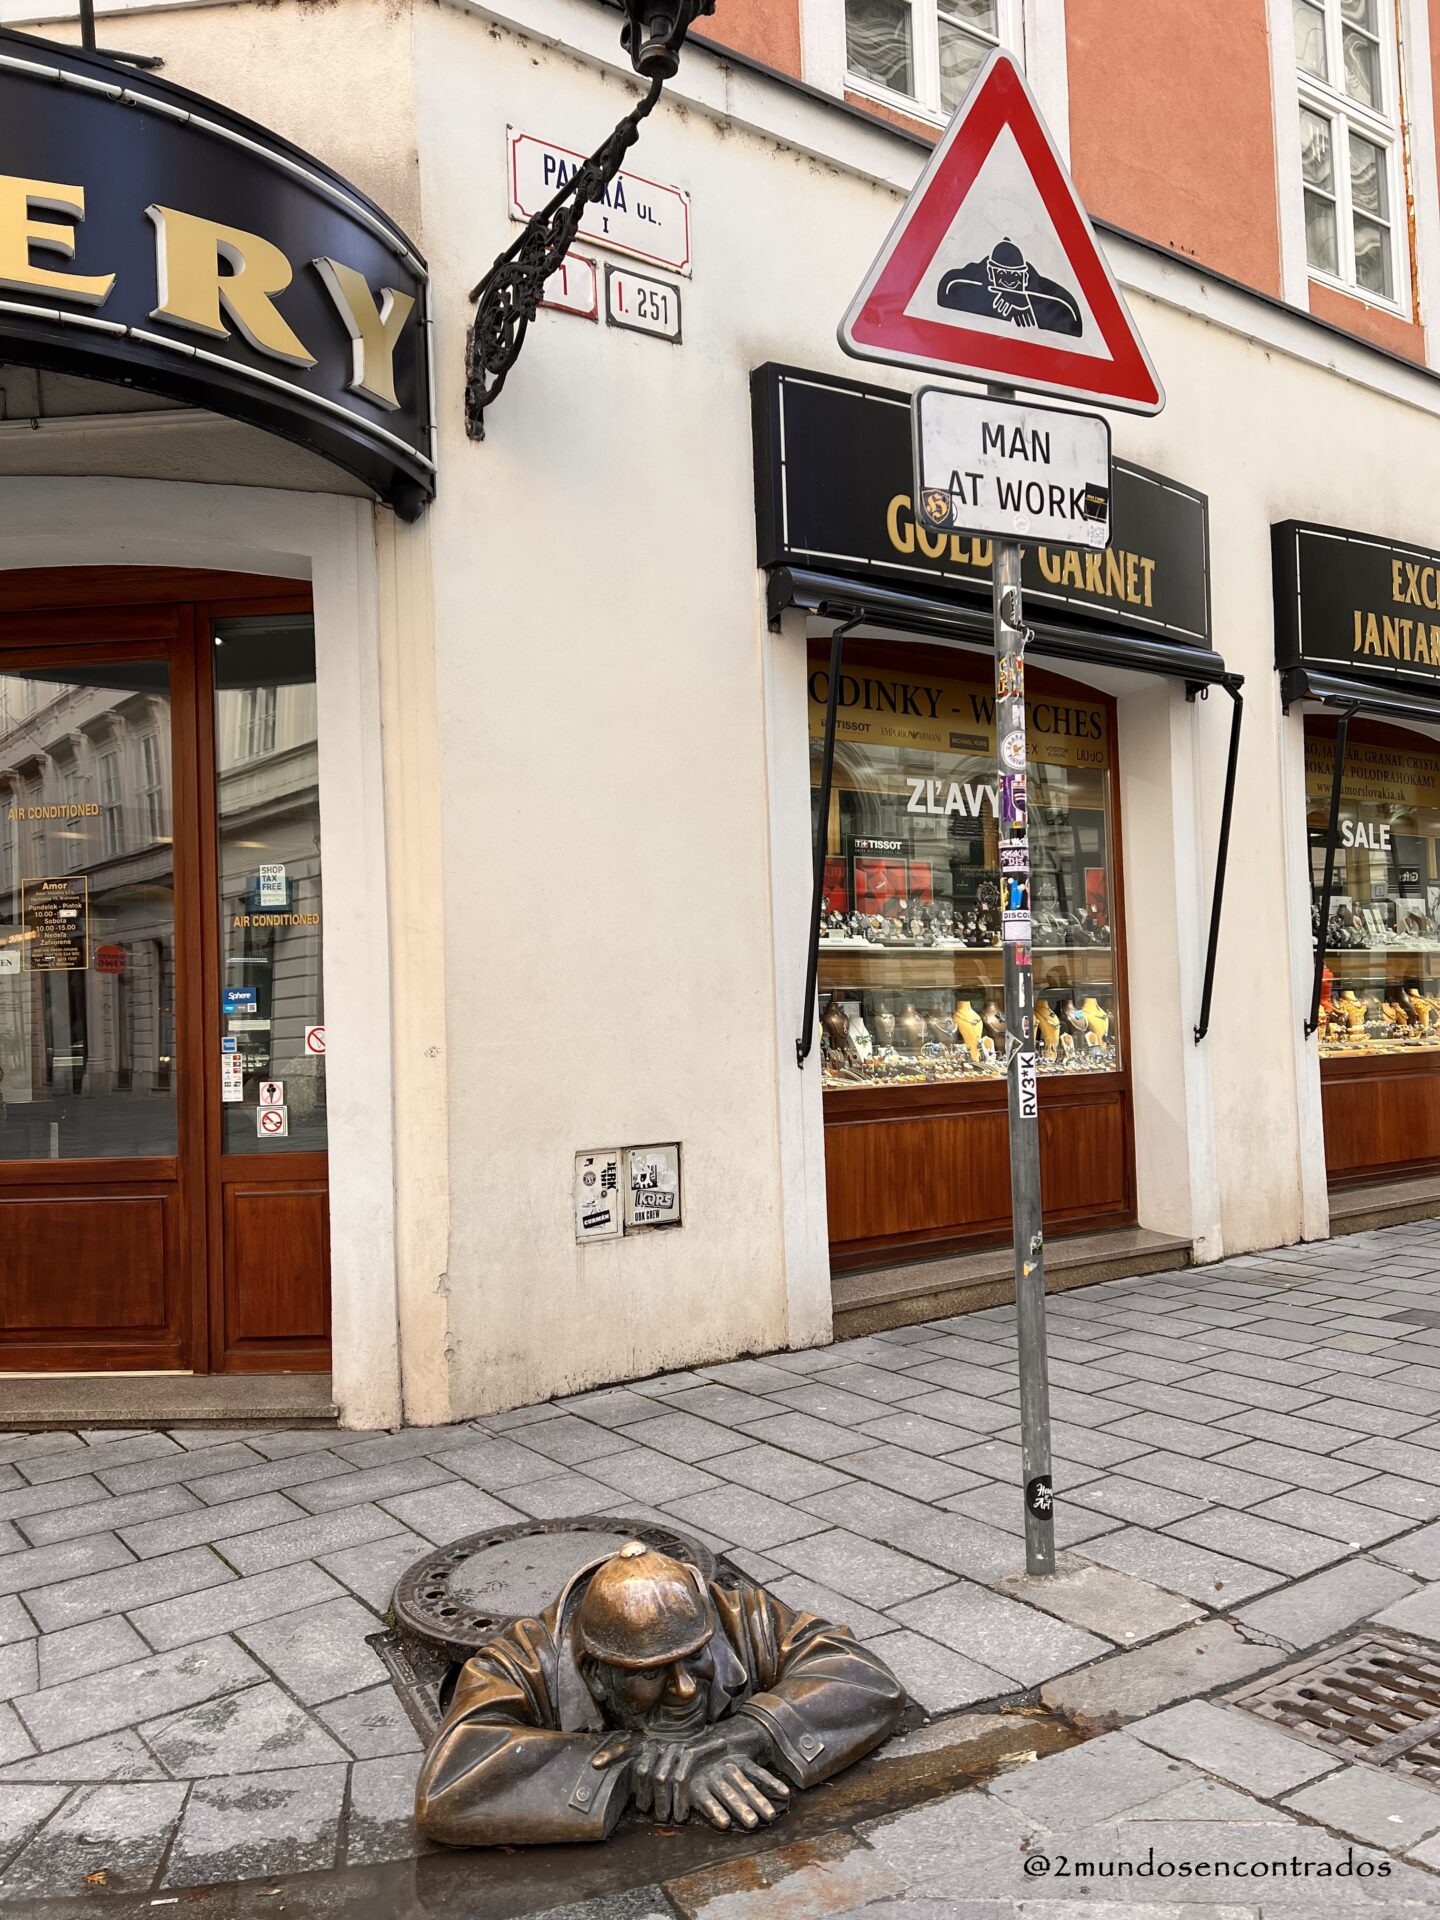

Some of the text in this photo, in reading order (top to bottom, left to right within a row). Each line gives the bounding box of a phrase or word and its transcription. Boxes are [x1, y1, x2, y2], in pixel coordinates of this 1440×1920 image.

[543, 152, 662, 226] PAKÁ UL.
[637, 288, 668, 325] 251
[981, 421, 1051, 464] MAN
[947, 469, 1088, 521] AT WORK
[1038, 546, 1156, 608] GARNET
[969, 693, 1102, 740] WCHES
[907, 777, 999, 818] ZĽAVY
[1317, 783, 1405, 801] wwamorslovakia.sk
[8, 803, 99, 821] AIR CONDITIONED
[1341, 820, 1391, 850] SALE
[261, 866, 283, 874] SHOP
[42, 882, 68, 890] Amor
[262, 882, 282, 890] FREE
[233, 913, 320, 928] AIR CONDITIONED
[228, 991, 251, 1001] Sphere
